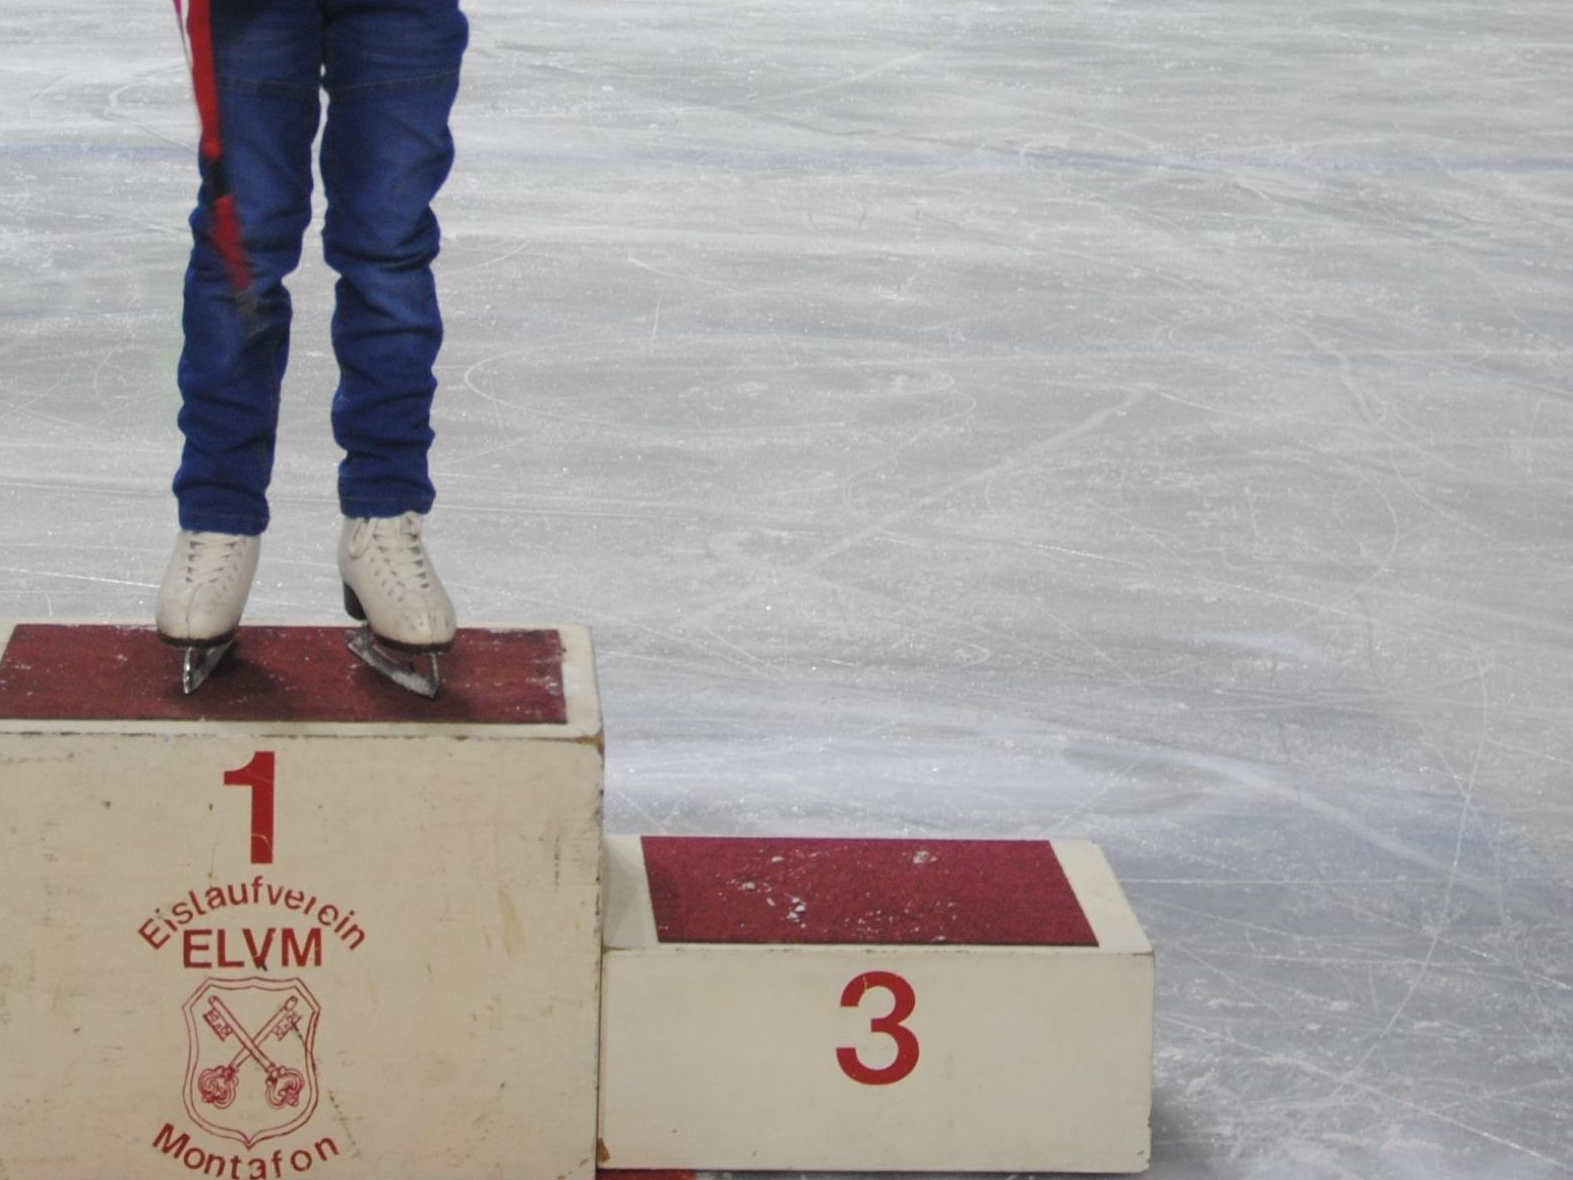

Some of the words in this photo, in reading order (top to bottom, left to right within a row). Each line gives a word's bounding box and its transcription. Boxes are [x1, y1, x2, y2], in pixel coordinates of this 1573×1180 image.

[223, 751, 275, 864] 1
[137, 875, 366, 951] Eislaufverein
[183, 928, 323, 968] ELVM
[836, 970, 920, 1086] 3
[152, 1123, 339, 1180] Montafon
